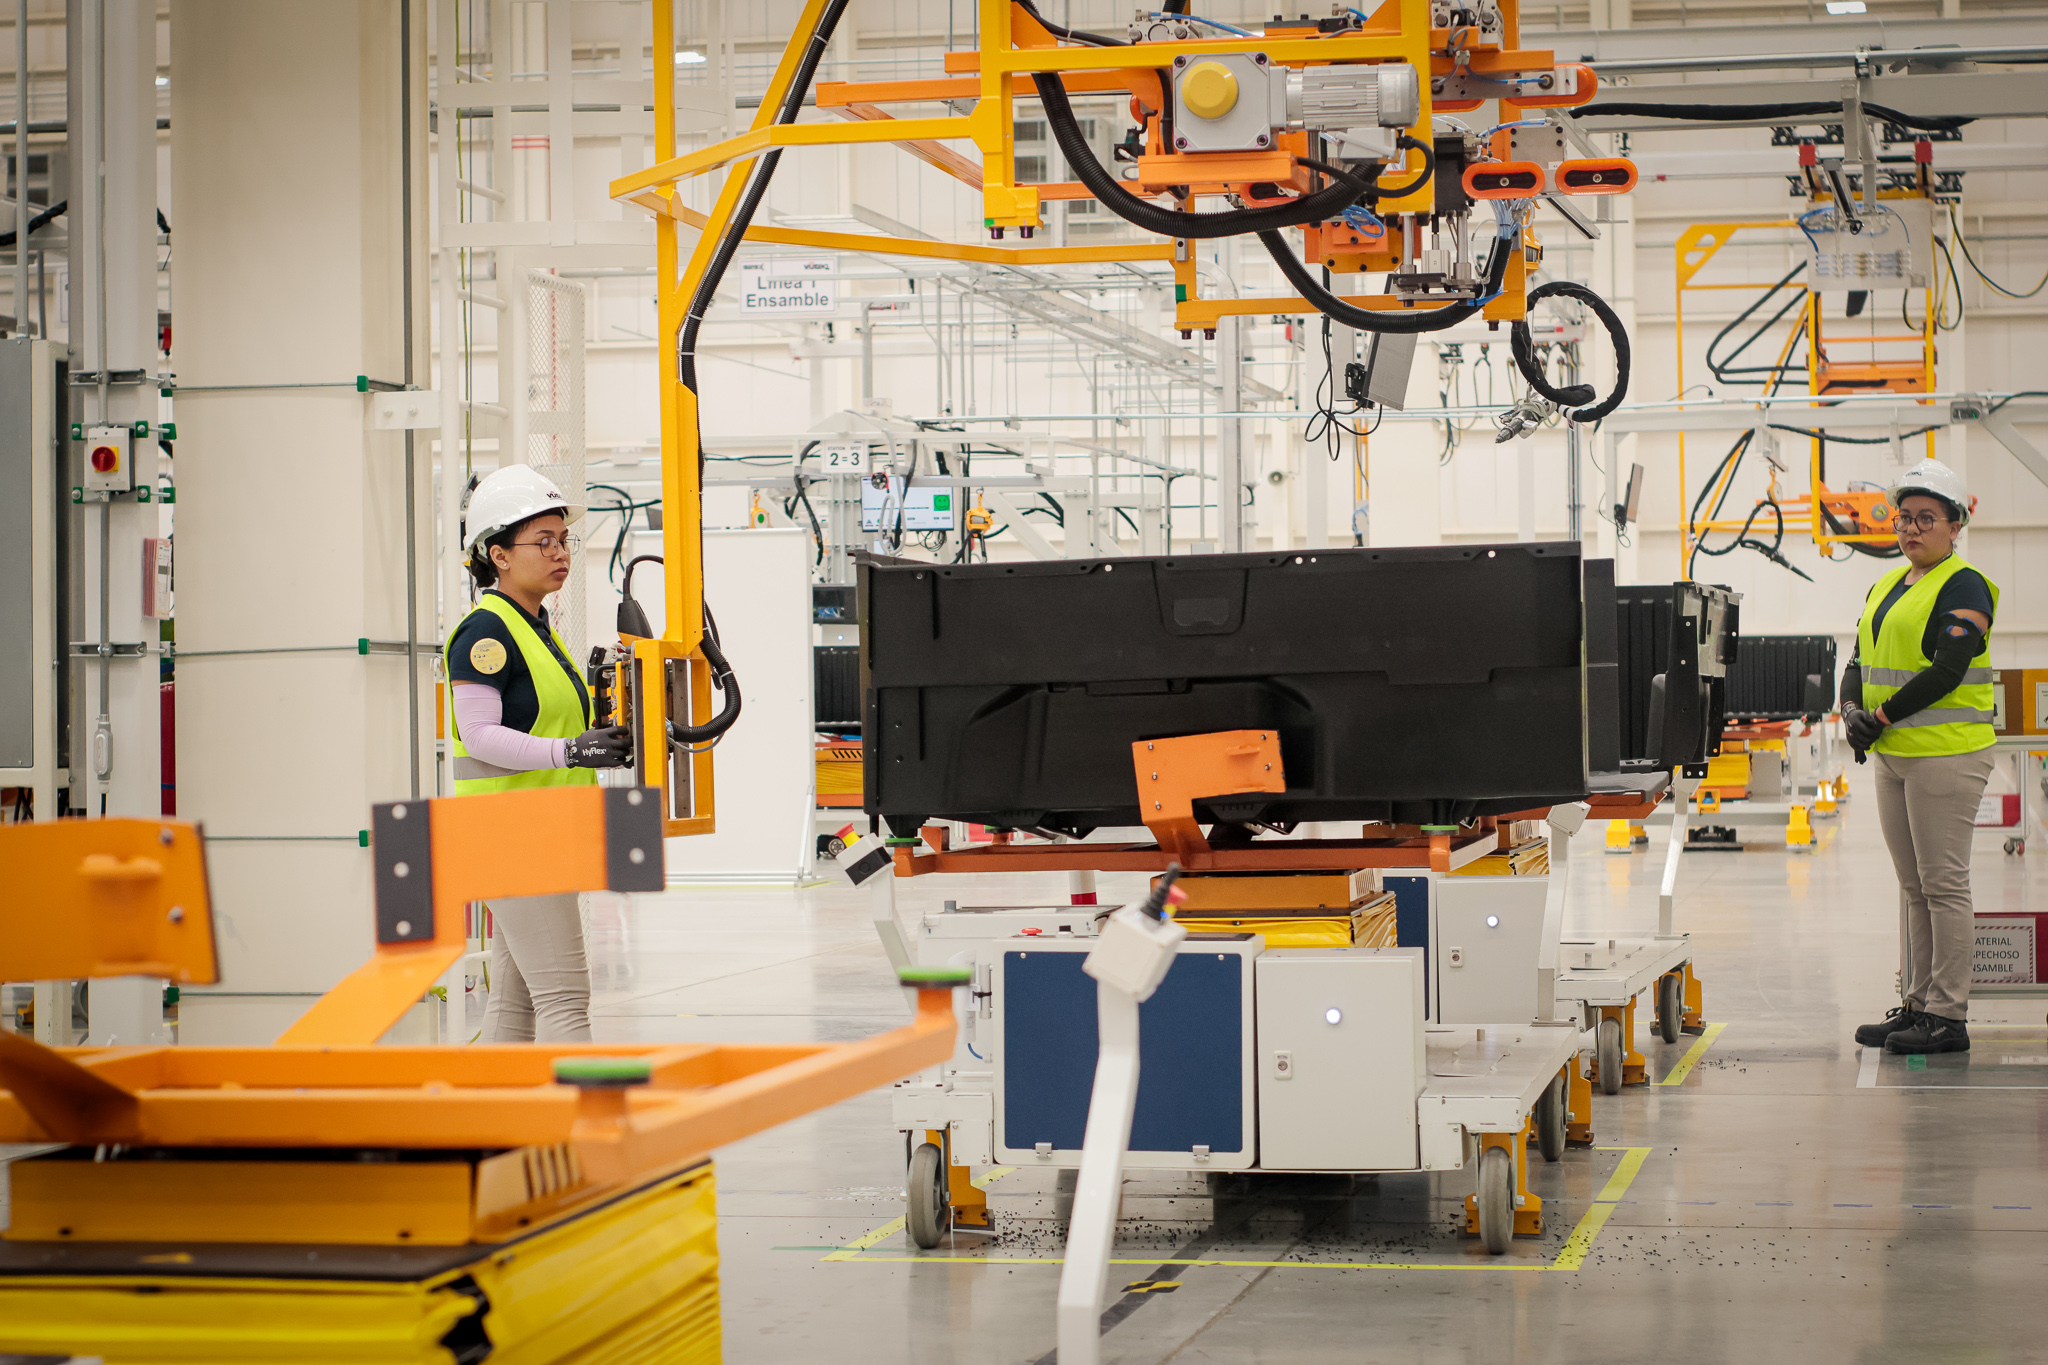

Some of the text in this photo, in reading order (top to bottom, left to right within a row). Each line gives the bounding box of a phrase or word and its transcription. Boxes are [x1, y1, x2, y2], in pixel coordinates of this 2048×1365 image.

[747, 292, 829, 307] Ensamble
[1975, 937, 2012, 946] ATERIAL
[1973, 950, 2020, 959] PECHOSO
